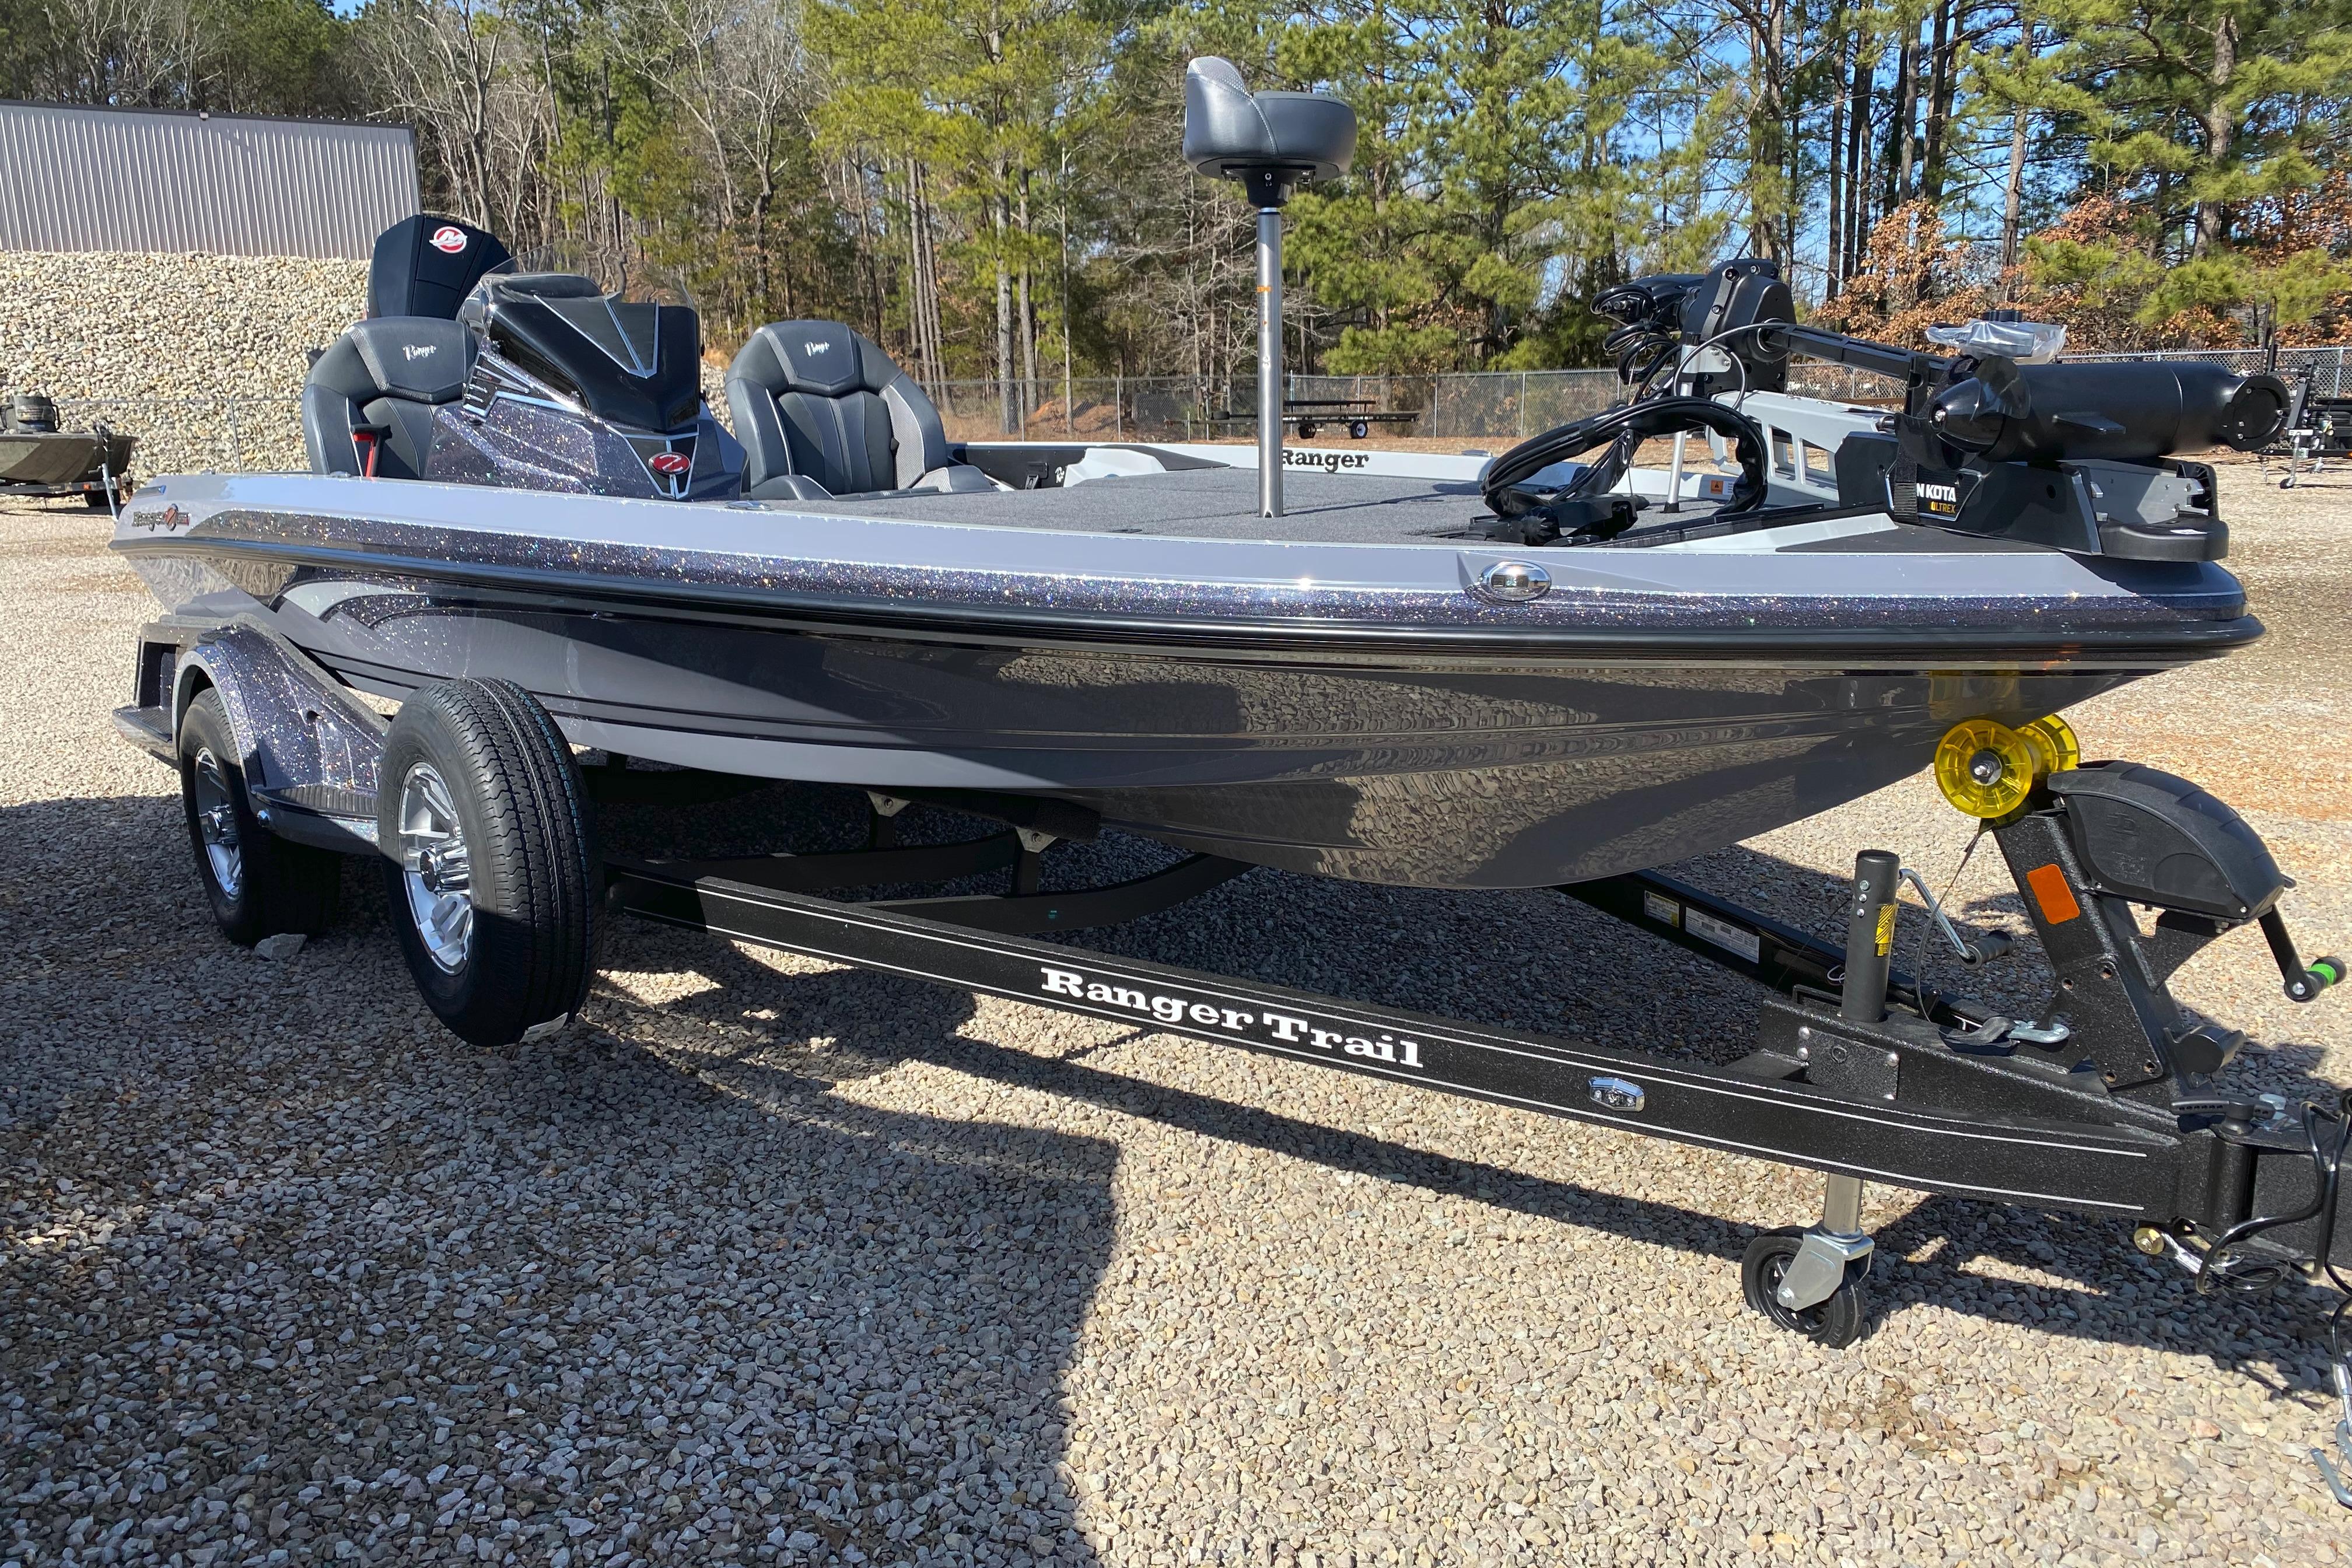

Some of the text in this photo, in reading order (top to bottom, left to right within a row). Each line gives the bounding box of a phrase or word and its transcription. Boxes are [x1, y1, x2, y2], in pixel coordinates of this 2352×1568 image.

[402, 344, 436, 361] Ranger
[1283, 449, 1369, 473] Ranger
[1926, 484, 1957, 502] KOTA
[1930, 501, 1957, 513] ULTREX
[1040, 967, 1424, 1068] Ranger Trail
